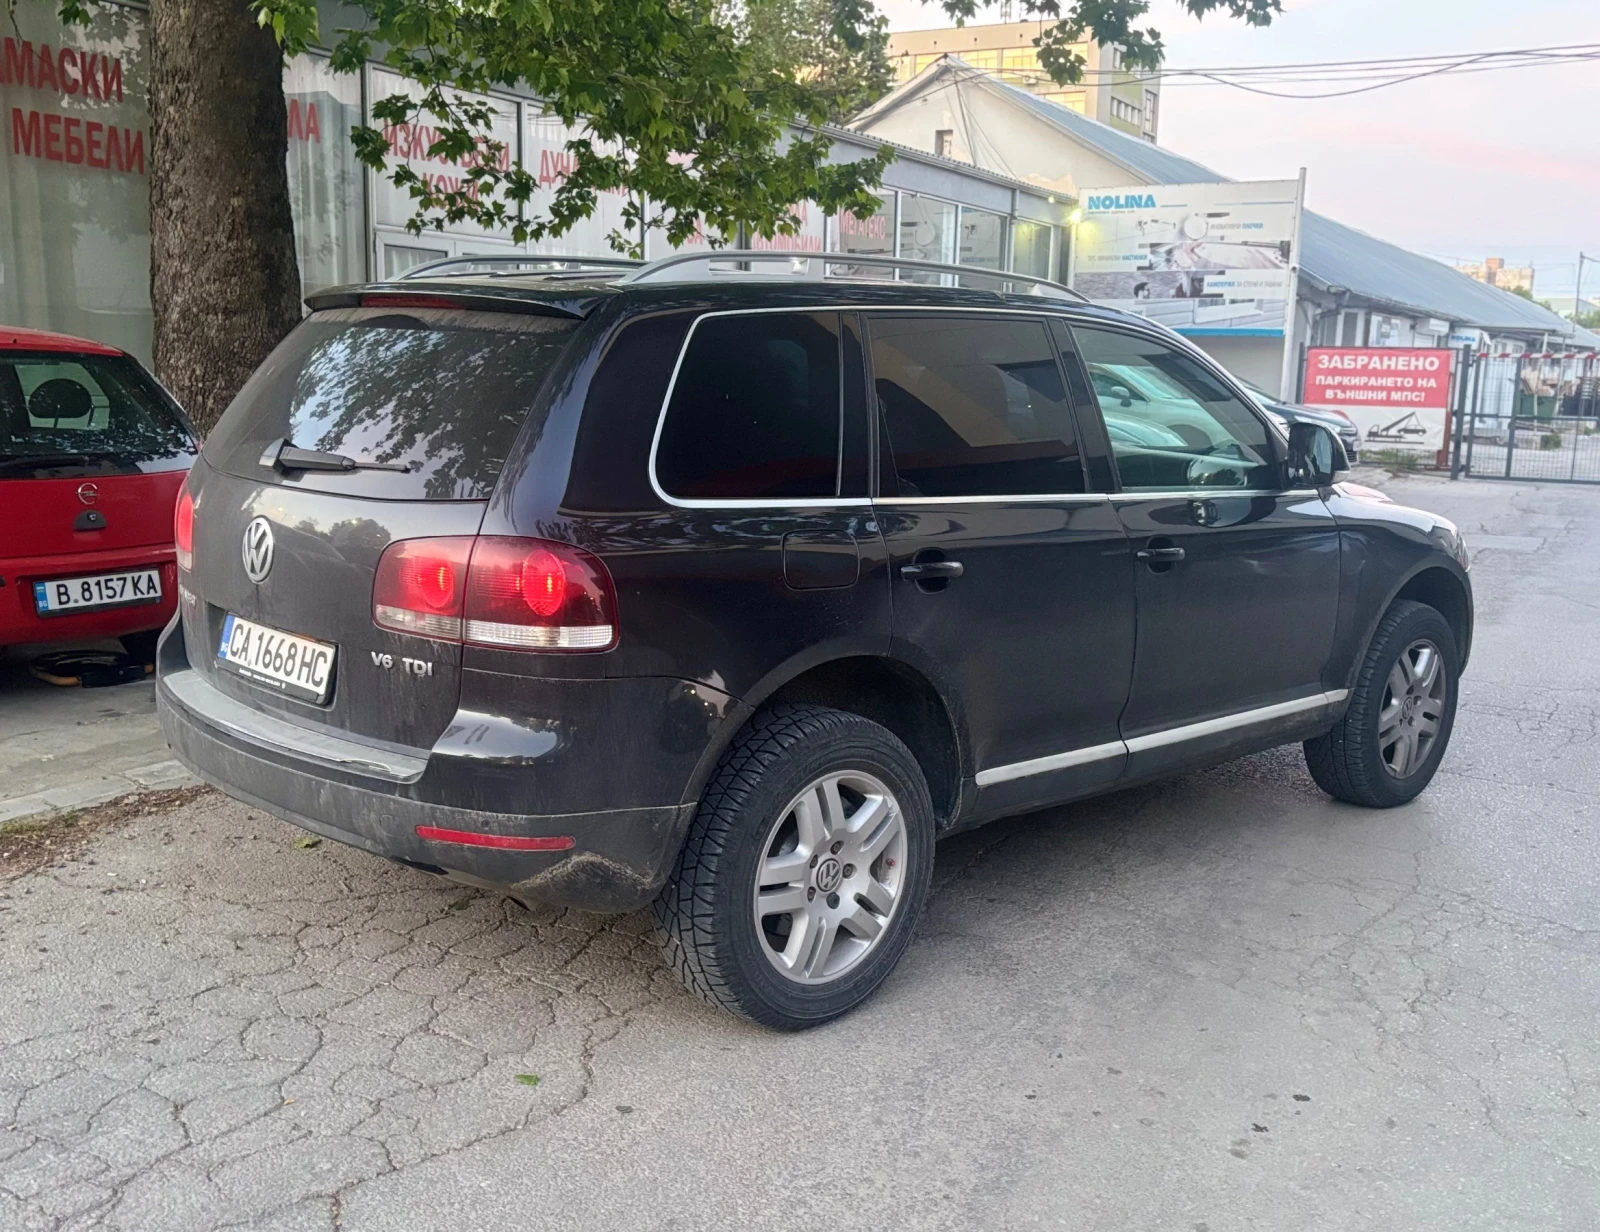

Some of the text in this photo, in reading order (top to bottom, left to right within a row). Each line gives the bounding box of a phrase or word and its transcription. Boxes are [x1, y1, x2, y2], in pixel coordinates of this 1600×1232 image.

[0, 36, 123, 102] МАСКИ
[12, 107, 145, 174] МЕБЕЛИ
[1087, 194, 1157, 210] NOLINA
[1317, 355, 1440, 371] ЗАБРАНЕНО
[1315, 375, 1437, 388] ПАРКИРАНЕТО НА
[1325, 389, 1425, 402] ВЪНШНИ МПС!
[370, 651, 433, 676] V6 TDI
